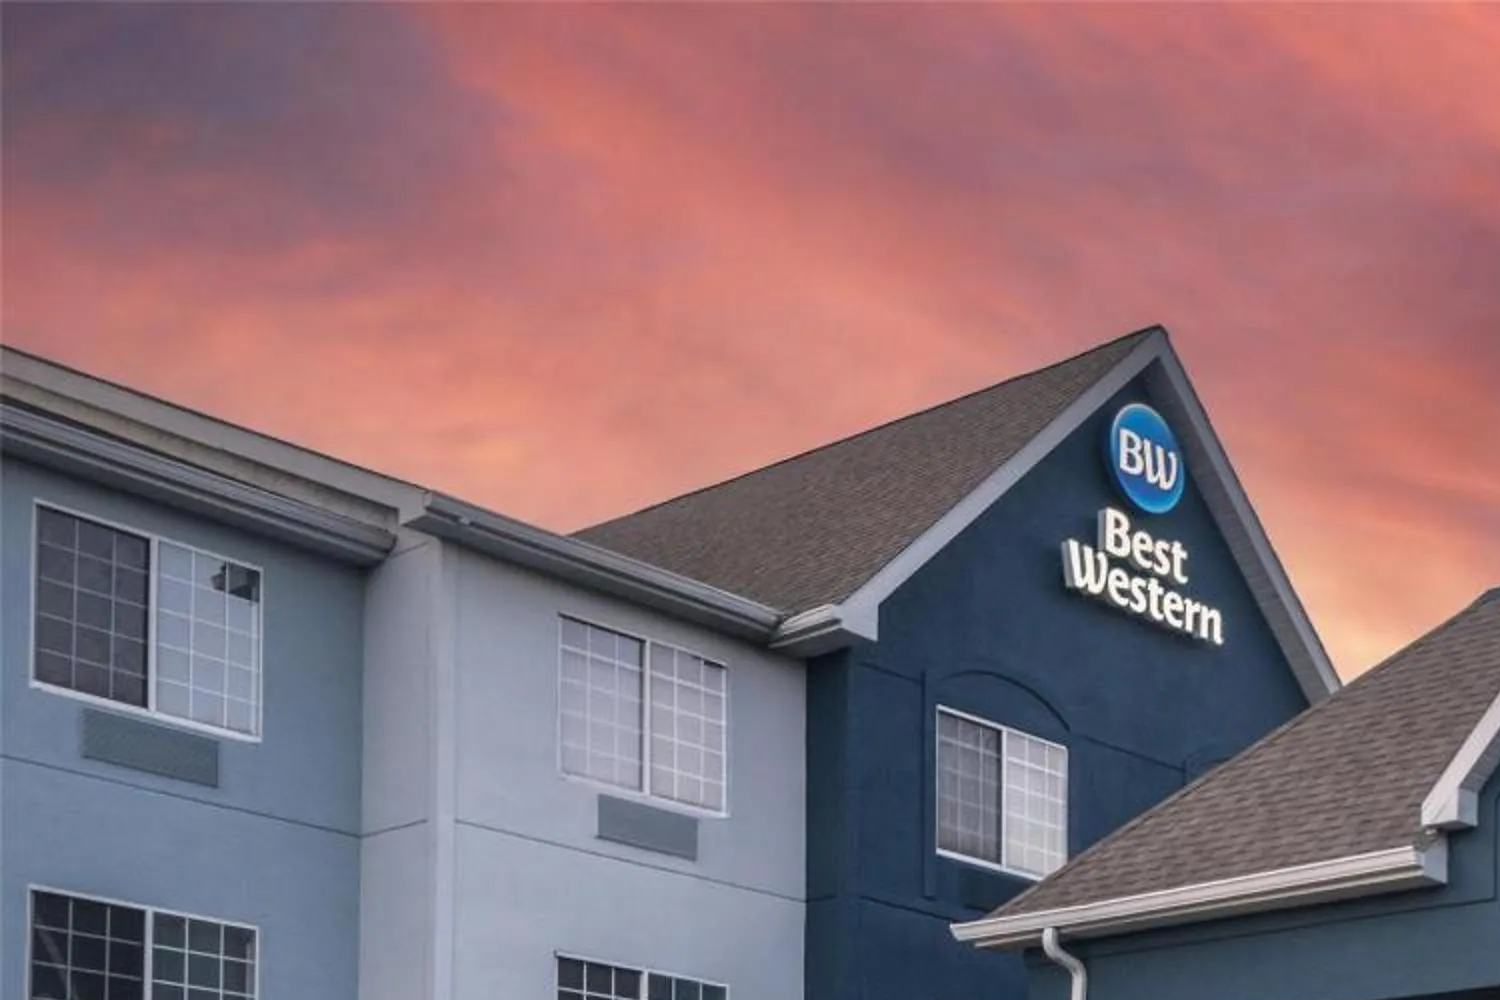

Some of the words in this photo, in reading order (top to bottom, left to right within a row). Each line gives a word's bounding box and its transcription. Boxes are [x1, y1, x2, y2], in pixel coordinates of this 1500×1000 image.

[1118, 428, 1177, 490] BW
[1102, 507, 1189, 584] Best
[1064, 538, 1224, 645] Western
